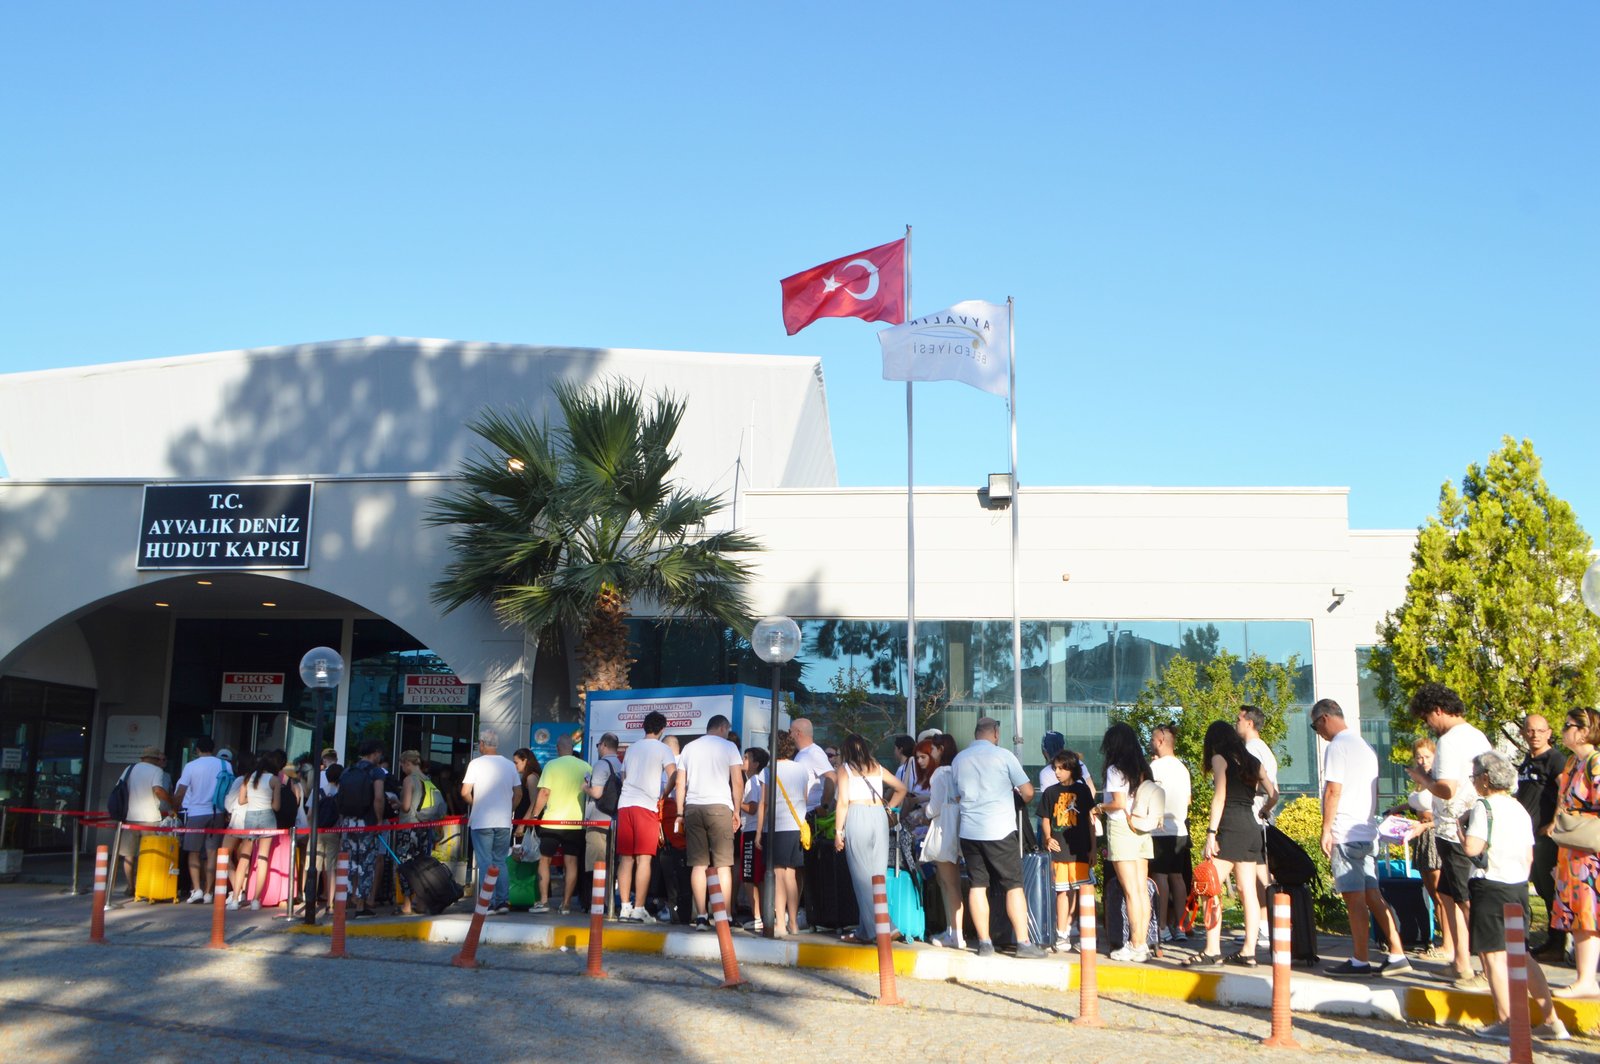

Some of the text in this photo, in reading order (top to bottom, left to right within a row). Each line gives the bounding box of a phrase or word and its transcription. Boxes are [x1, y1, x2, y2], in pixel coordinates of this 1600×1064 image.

[209, 493, 243, 509] T.C.
[148, 514, 300, 535] AYVALIK DENİZ
[145, 540, 300, 558] HUDUT KAPISI
[241, 685, 265, 693] EXIT
[407, 687, 466, 695] ENTRANCE
[743, 840, 753, 878] FOOTBALL
